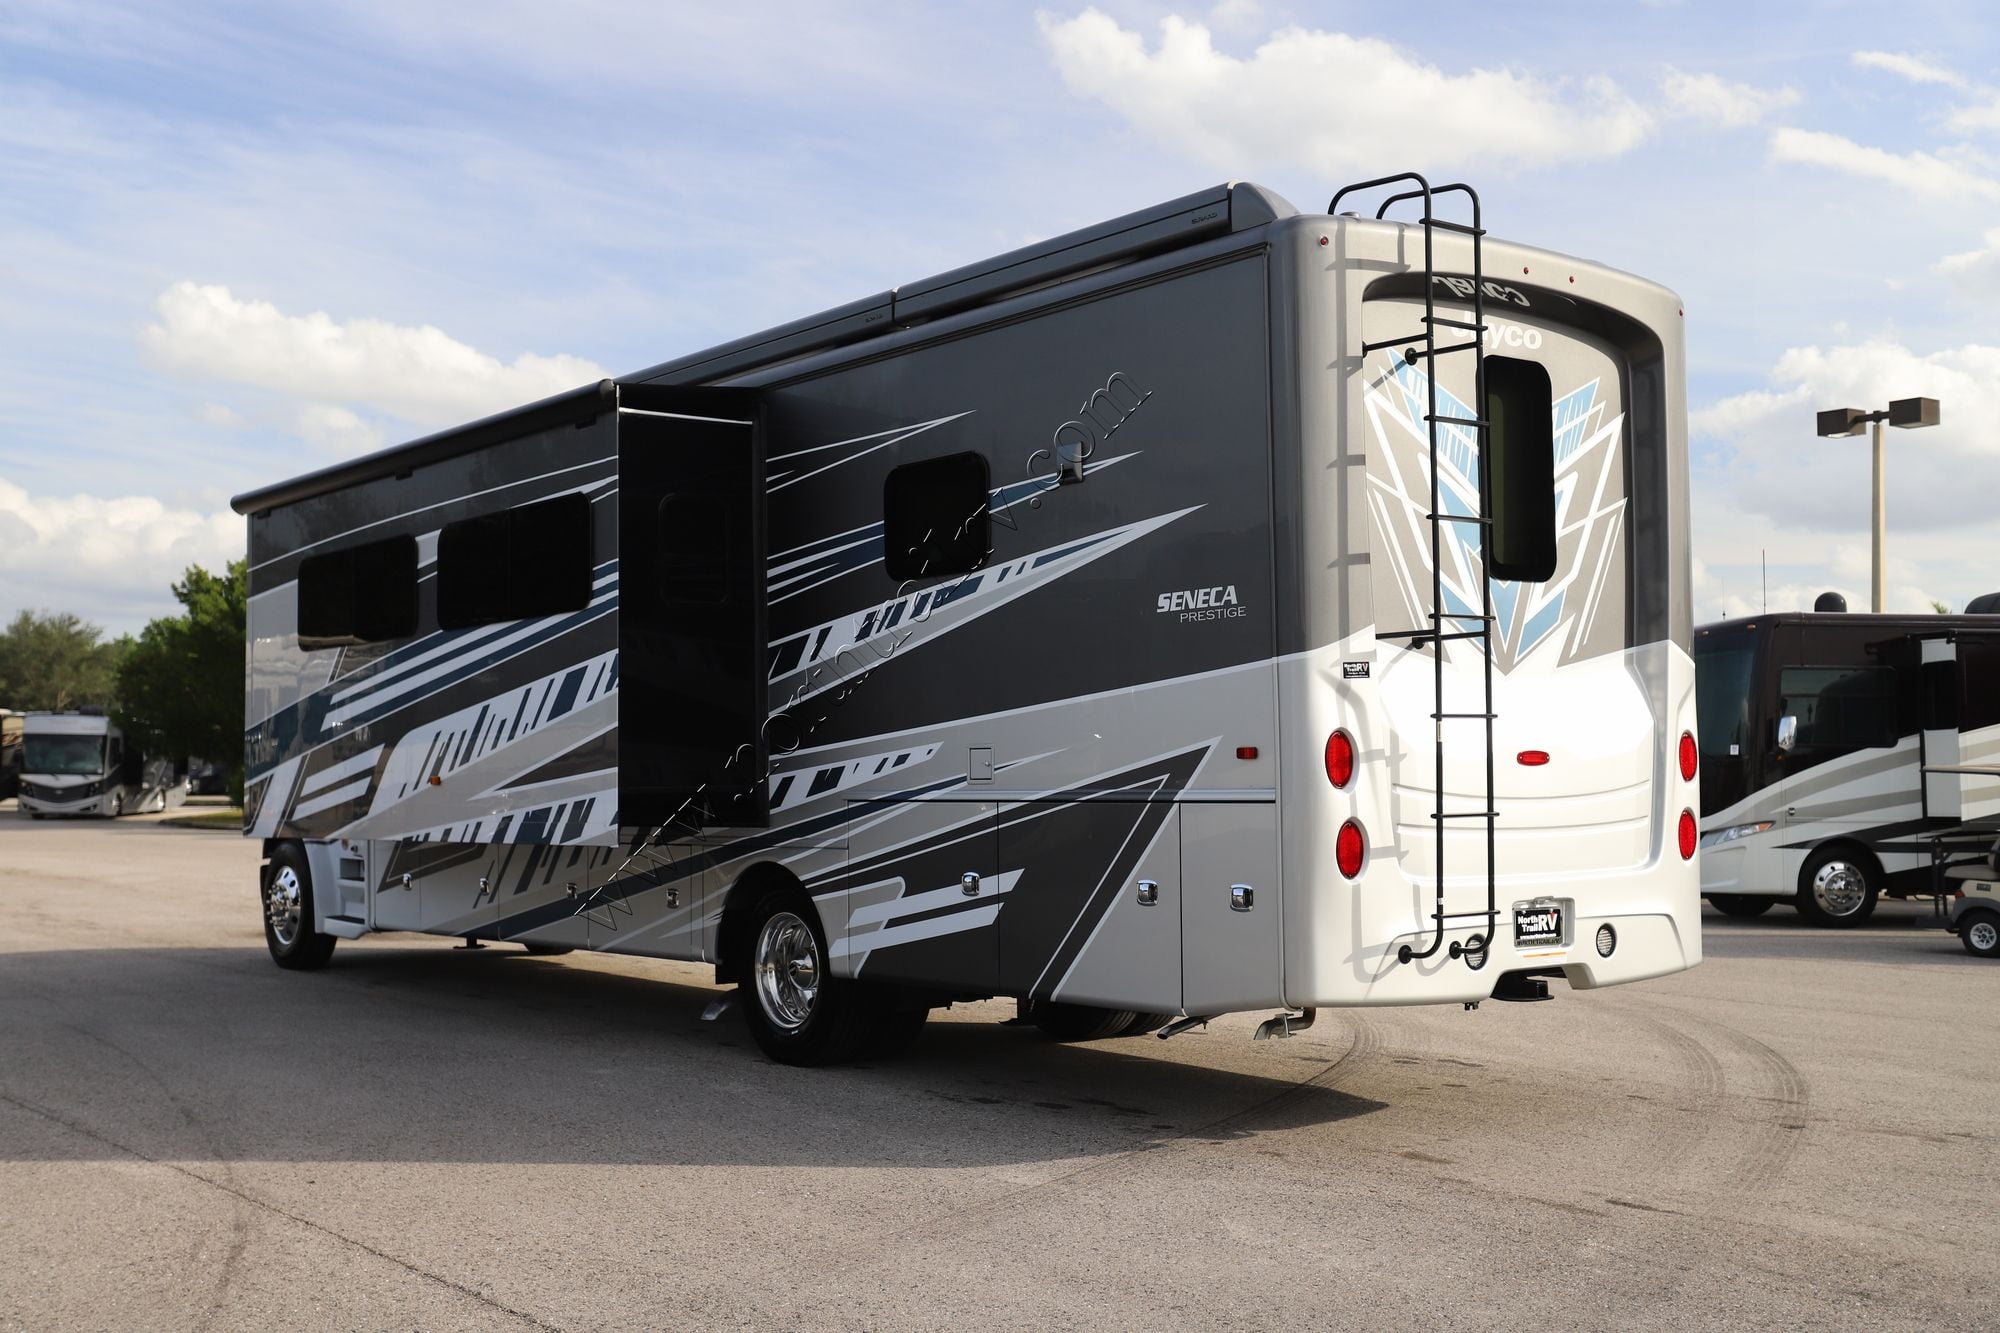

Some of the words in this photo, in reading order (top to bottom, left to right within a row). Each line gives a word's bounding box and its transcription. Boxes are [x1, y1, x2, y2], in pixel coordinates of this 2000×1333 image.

[1157, 585, 1238, 613] SENECA
[1180, 606, 1247, 623] PRESTIGE
[1357, 664, 1368, 672] RV
[1518, 915, 1538, 924] North
[1538, 914, 1558, 931] RV
[1522, 923, 1538, 932] Trail
